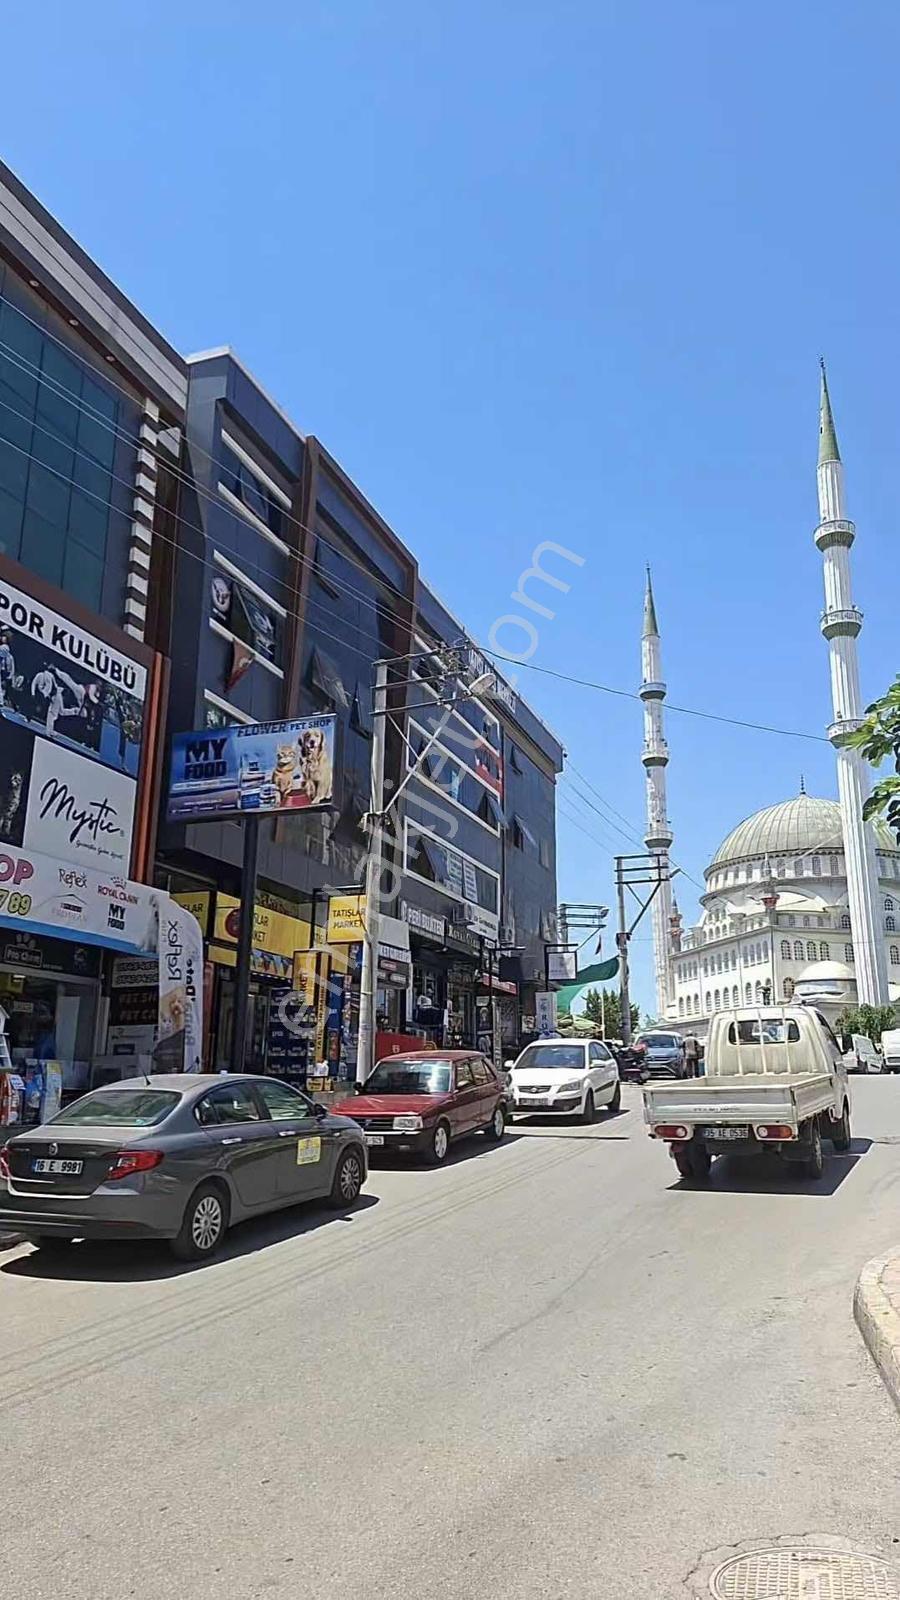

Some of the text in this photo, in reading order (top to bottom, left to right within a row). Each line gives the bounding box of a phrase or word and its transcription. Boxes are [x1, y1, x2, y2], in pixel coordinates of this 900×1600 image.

[51, 624, 137, 690] KULÜBÜ
[237, 718, 332, 737] FLOWER PET SHOP
[186, 737, 228, 764] MY
[184, 761, 227, 780] FOOD
[40, 777, 121, 844] Mystic
[108, 903, 126, 920] MY
[37, 1160, 45, 1171] 16
[48, 1160, 56, 1172] E
